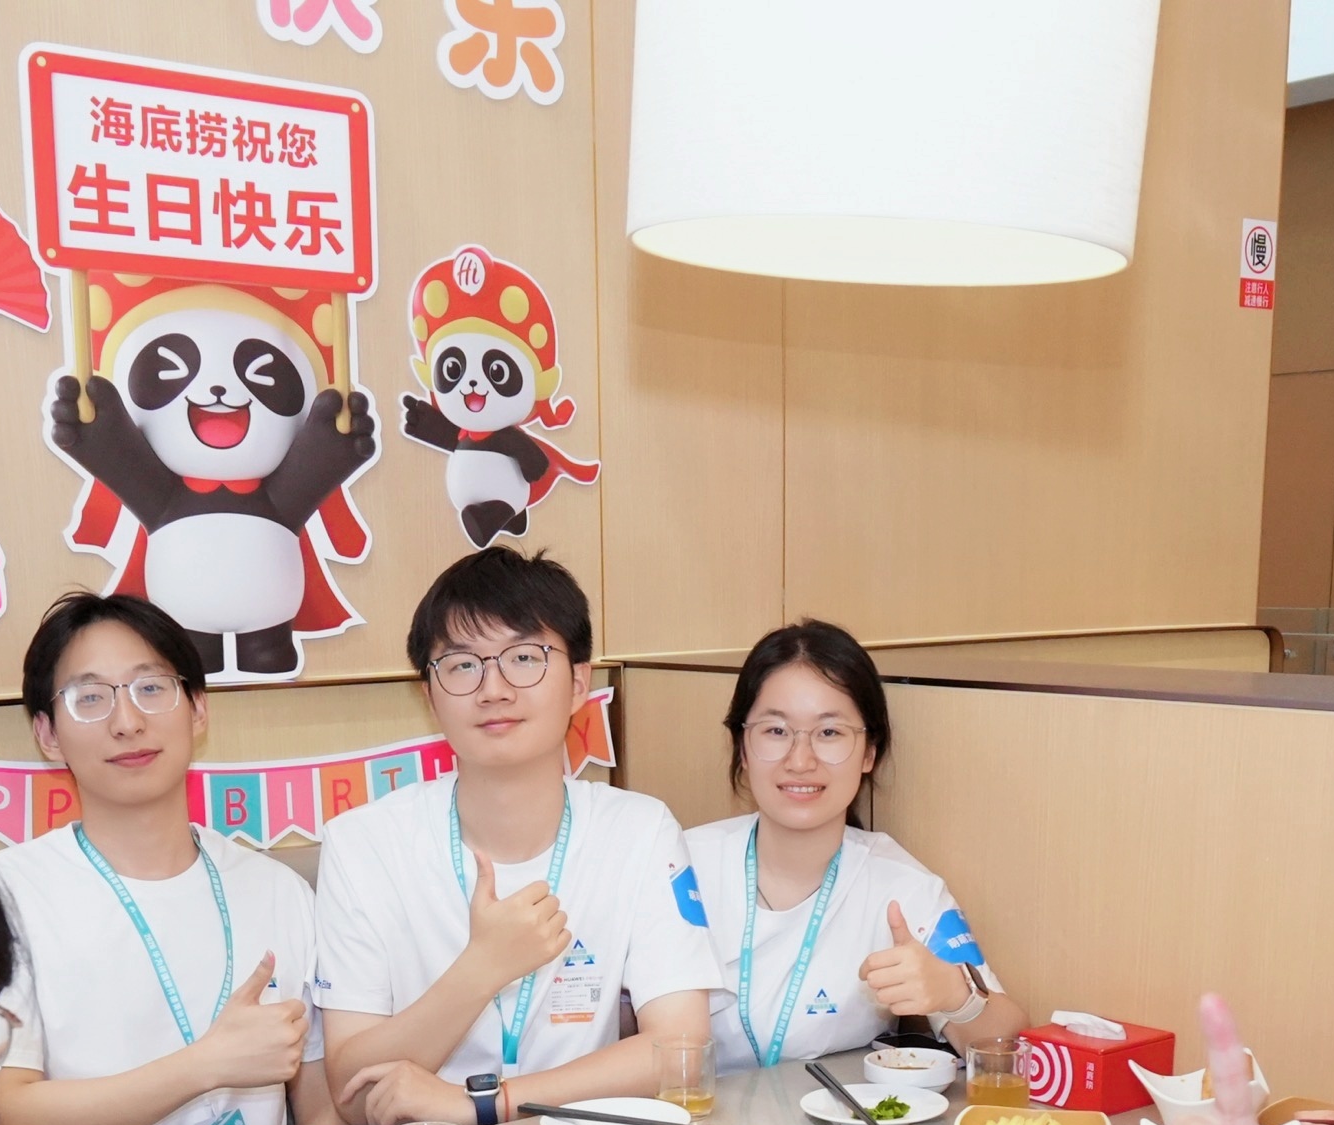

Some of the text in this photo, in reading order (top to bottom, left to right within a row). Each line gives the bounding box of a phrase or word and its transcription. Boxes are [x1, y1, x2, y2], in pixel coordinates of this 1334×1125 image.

[88, 94, 319, 169] 海底捞祝您
[66, 163, 345, 258] 生日快乐
[1250, 232, 1267, 267] 慢
[456, 256, 481, 286] Hi
[1244, 281, 1269, 295] 注意行人
[1244, 294, 1269, 307] 减速慢行
